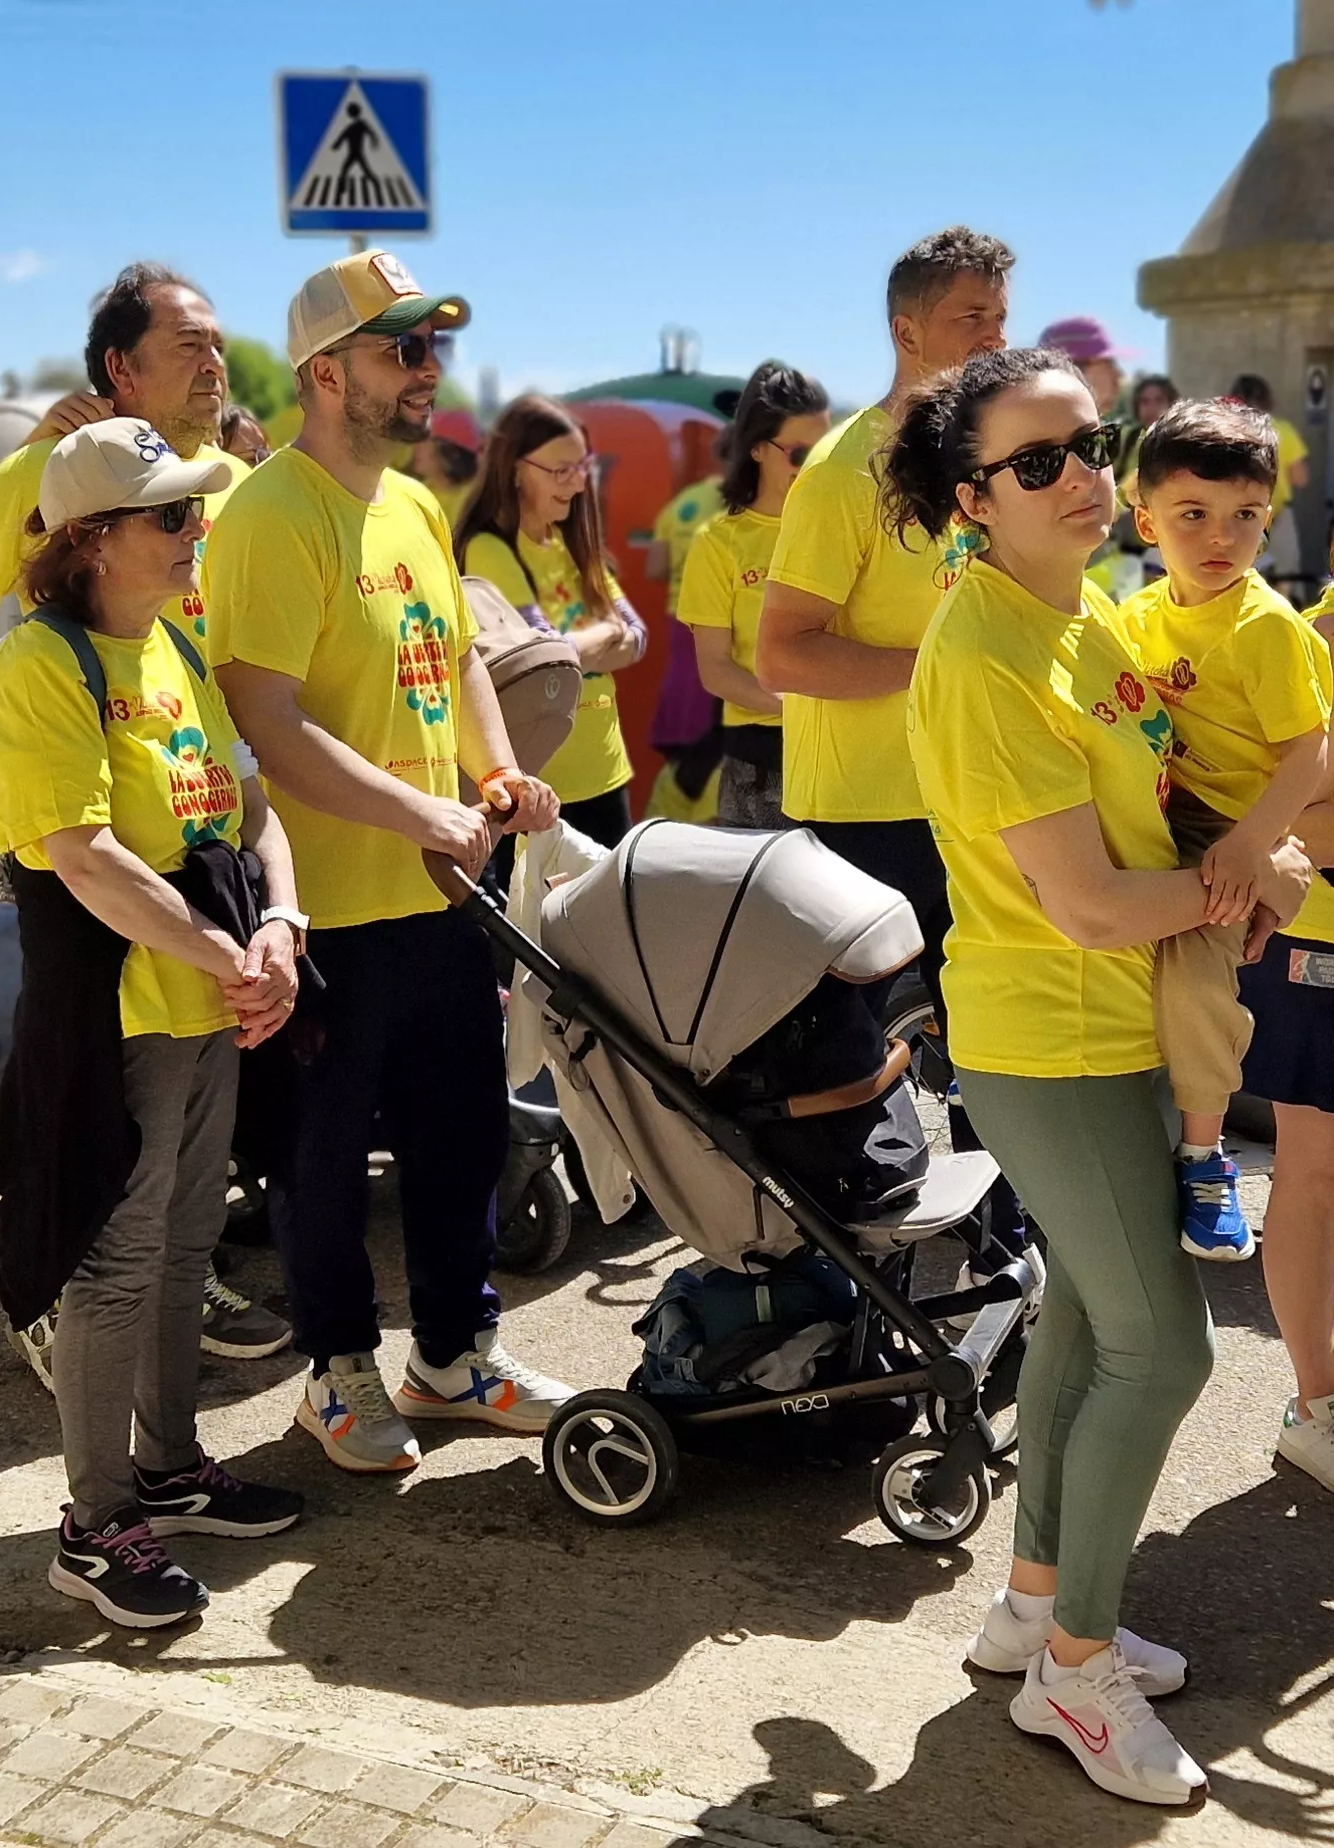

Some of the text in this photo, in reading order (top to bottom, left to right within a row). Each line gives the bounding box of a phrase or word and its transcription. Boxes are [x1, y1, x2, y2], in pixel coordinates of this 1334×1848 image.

[356, 575, 374, 597] 13
[740, 568, 759, 586] 13
[106, 699, 130, 721] 13
[1090, 702, 1118, 726] 13
[168, 770, 185, 793] LA
[762, 1176, 795, 1209] mutsy
